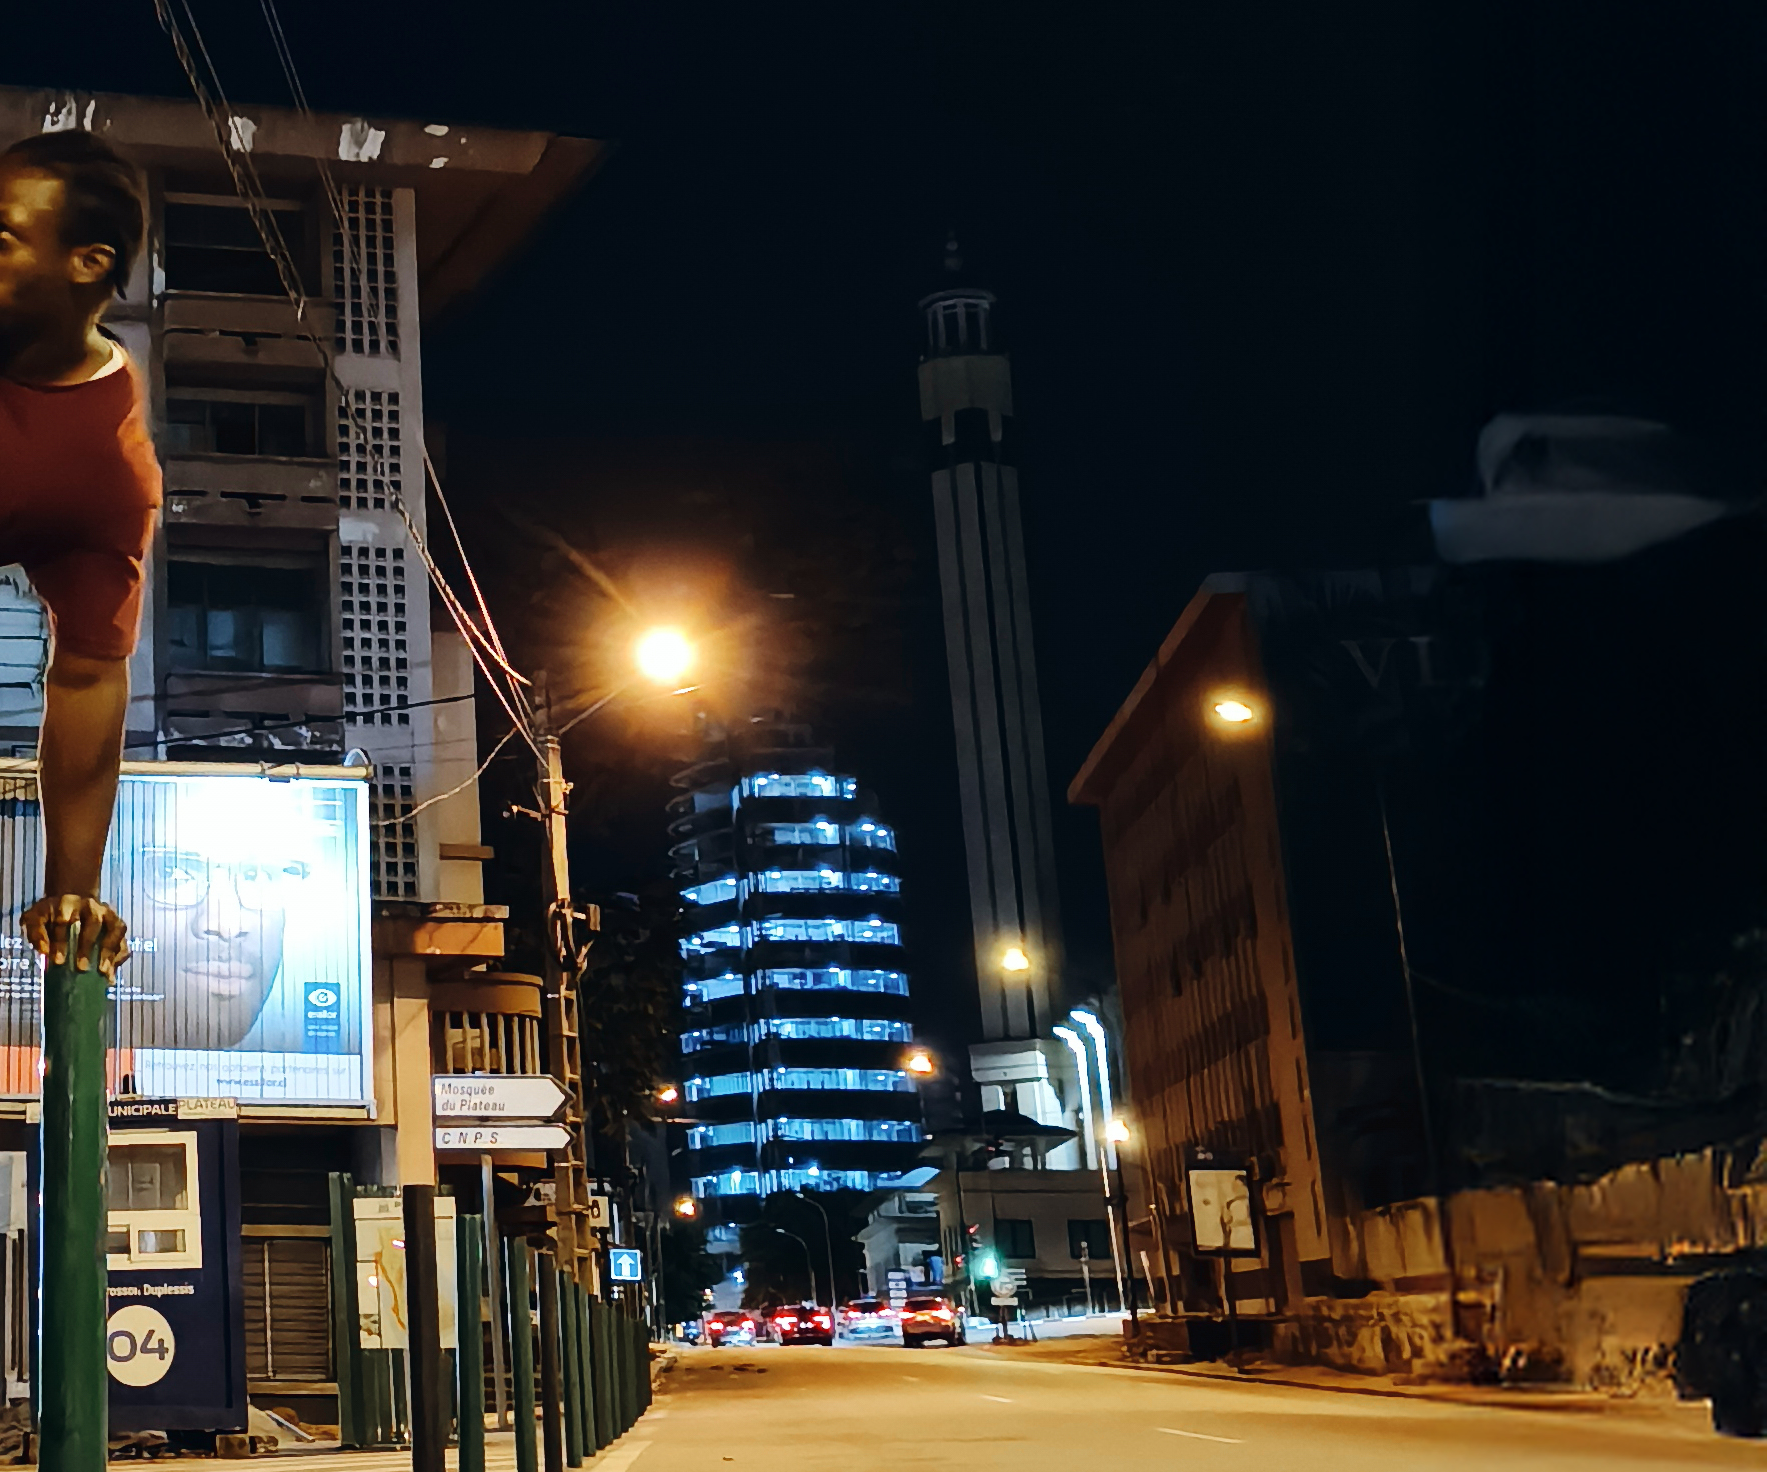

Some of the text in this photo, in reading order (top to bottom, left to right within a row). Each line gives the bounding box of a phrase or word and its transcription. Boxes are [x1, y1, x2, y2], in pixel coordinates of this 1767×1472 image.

[440, 1083, 495, 1097] Mosquée
[108, 1099, 236, 1117] UNICIPALE PLATEAU
[441, 1098, 506, 1112] du Plateau
[107, 1329, 170, 1363] 04
